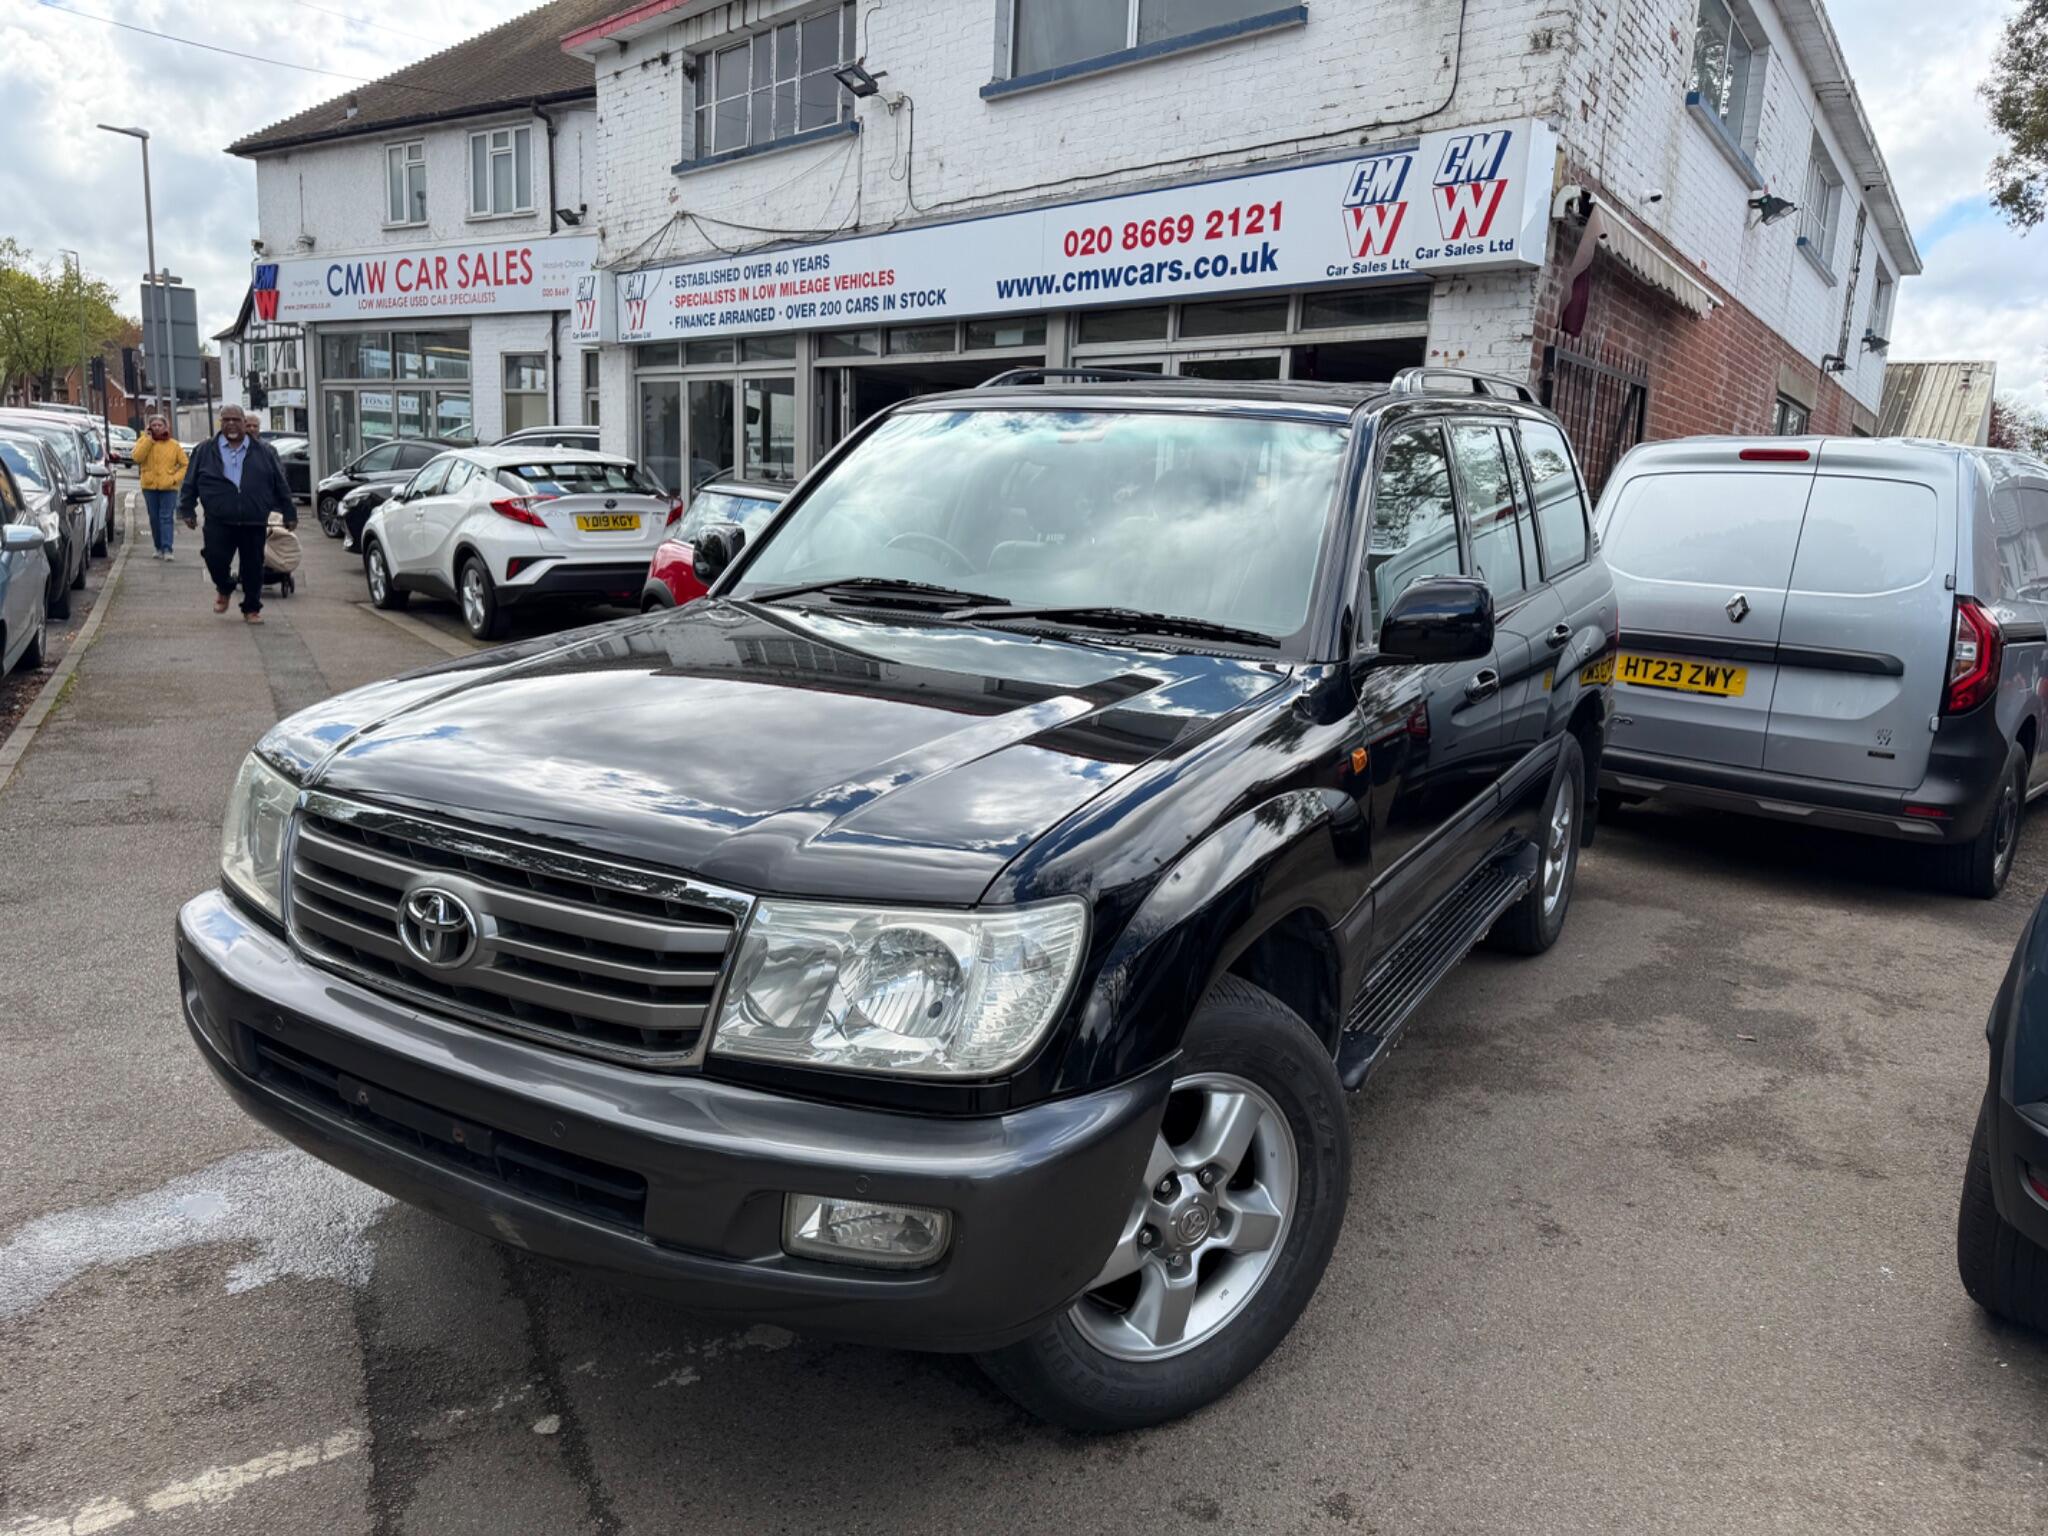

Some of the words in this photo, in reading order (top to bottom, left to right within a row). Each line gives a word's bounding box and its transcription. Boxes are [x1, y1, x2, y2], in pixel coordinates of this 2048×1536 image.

[1433, 129, 1512, 187] CM
[1343, 155, 1413, 208] CM
[1063, 225, 1112, 258] 020
[1122, 214, 1195, 251] 8669
[1204, 201, 1283, 240] 2121
[1342, 201, 1409, 259] W
[1432, 179, 1509, 241] W
[675, 267, 740, 288] ESTABLISHED
[743, 263, 772, 280] OVER
[776, 261, 789, 275] 40
[793, 254, 830, 273] YEARS
[996, 241, 1280, 300] www.cmwcars.co.uk
[1326, 264, 1349, 277] Car
[1351, 259, 1388, 274] Sales
[1415, 246, 1440, 260] Car
[1444, 242, 1484, 257] Sales
[1489, 238, 1514, 252] Ltd
[327, 261, 387, 297] CMW
[395, 256, 448, 292] CAR
[457, 248, 533, 289] SALES
[675, 288, 736, 308] SPECIALISTS
[739, 287, 749, 301] IN
[753, 284, 776, 300] LOW
[780, 277, 830, 297] MILEAGE
[834, 269, 895, 291] VEHICLES
[358, 300, 373, 310] LOW
[376, 297, 408, 309] MILEAGE
[410, 296, 428, 307] USED
[431, 294, 448, 306] CAR
[450, 291, 496, 305] SPECIALISTS
[675, 312, 716, 329] FINANCE
[718, 307, 775, 326] ARRANGED
[786, 302, 816, 320] OVER
[820, 301, 842, 316] 200
[846, 296, 879, 314] CARS
[883, 294, 896, 310] IN
[900, 288, 947, 309] STOCK
[1624, 656, 1684, 683] HT23
[1688, 665, 1737, 689] ZWY
